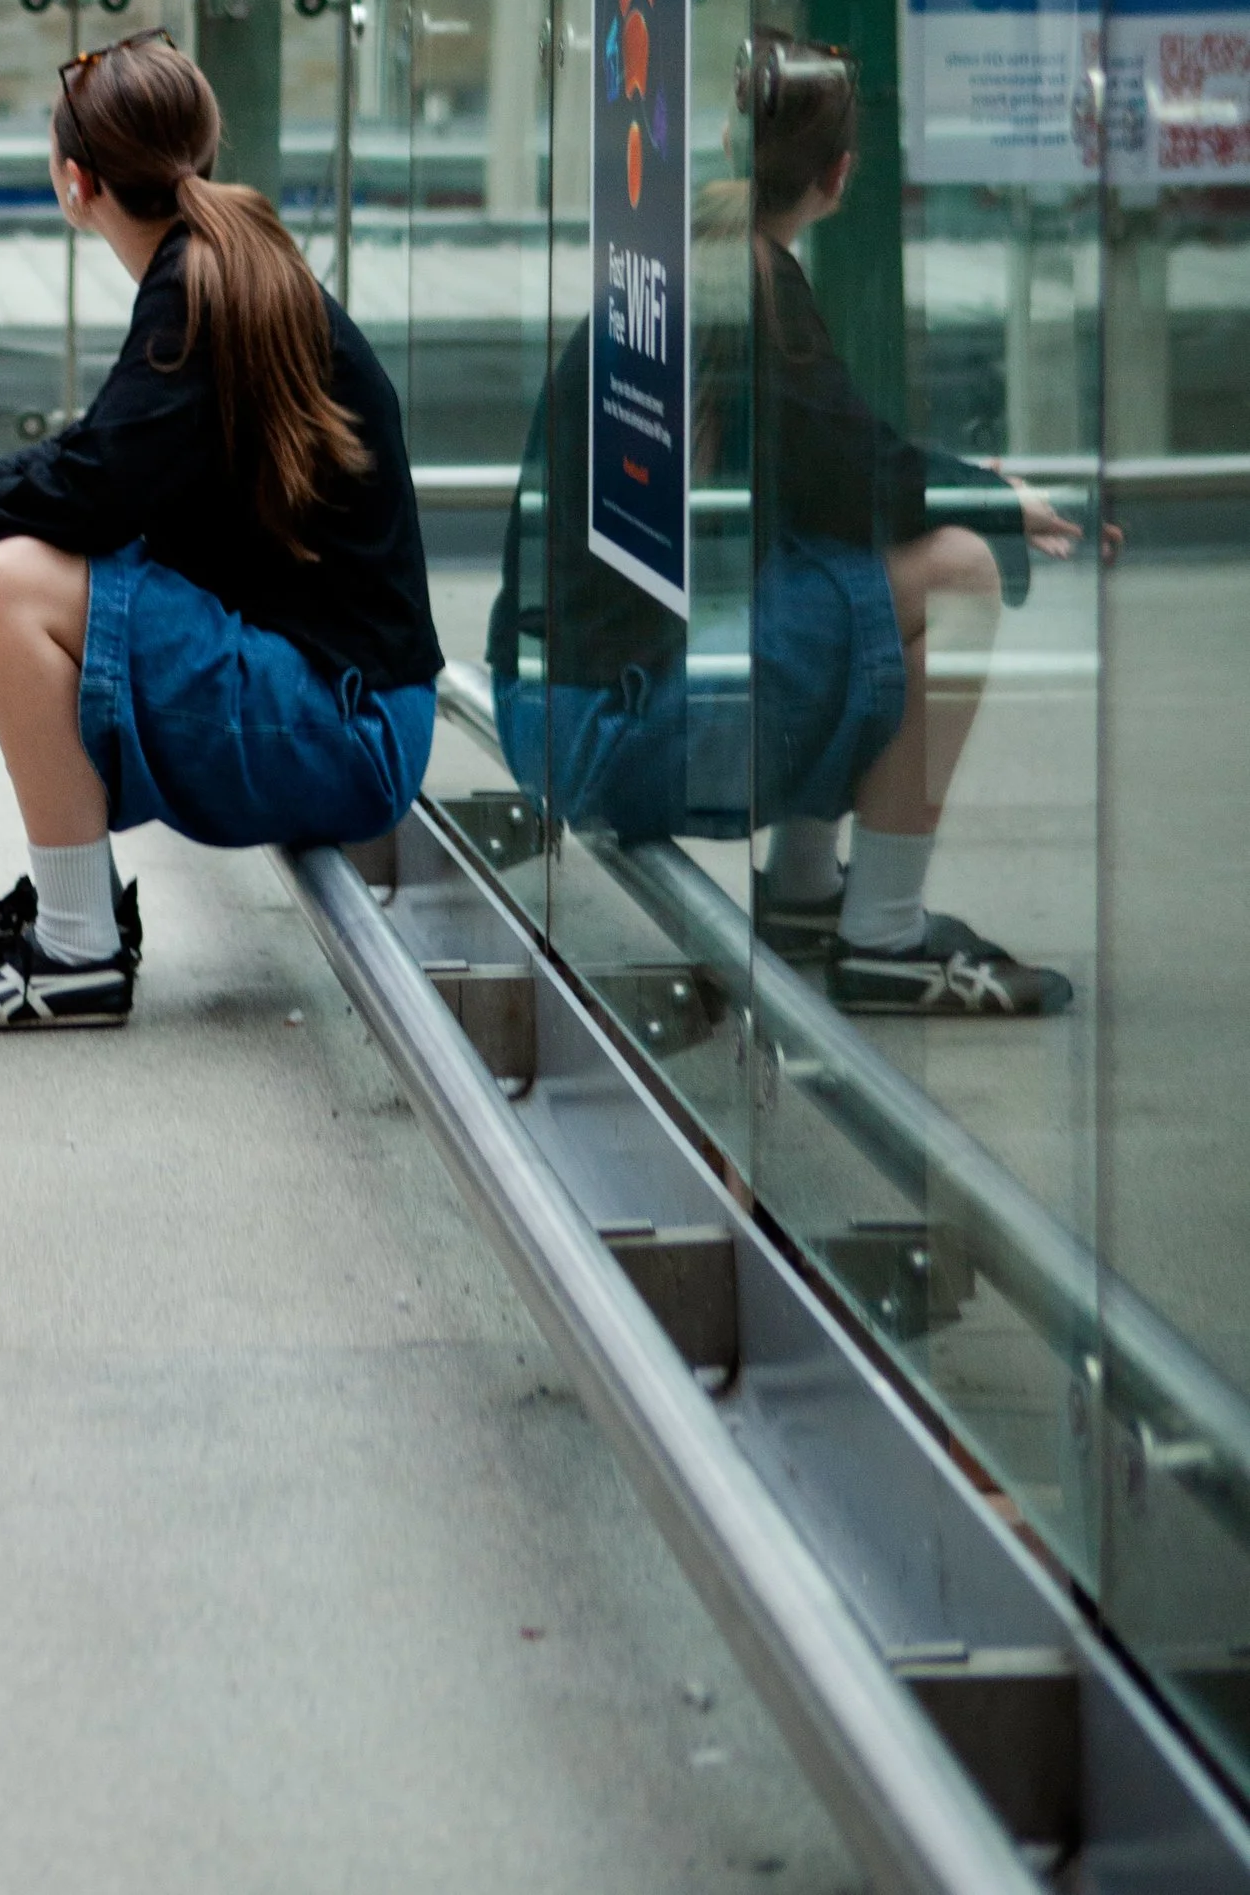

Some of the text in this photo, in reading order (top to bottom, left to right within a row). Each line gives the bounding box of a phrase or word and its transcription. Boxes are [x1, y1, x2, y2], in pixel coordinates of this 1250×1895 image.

[609, 242, 625, 290] Fast
[608, 296, 625, 346] Free
[626, 250, 667, 365] WiFi
